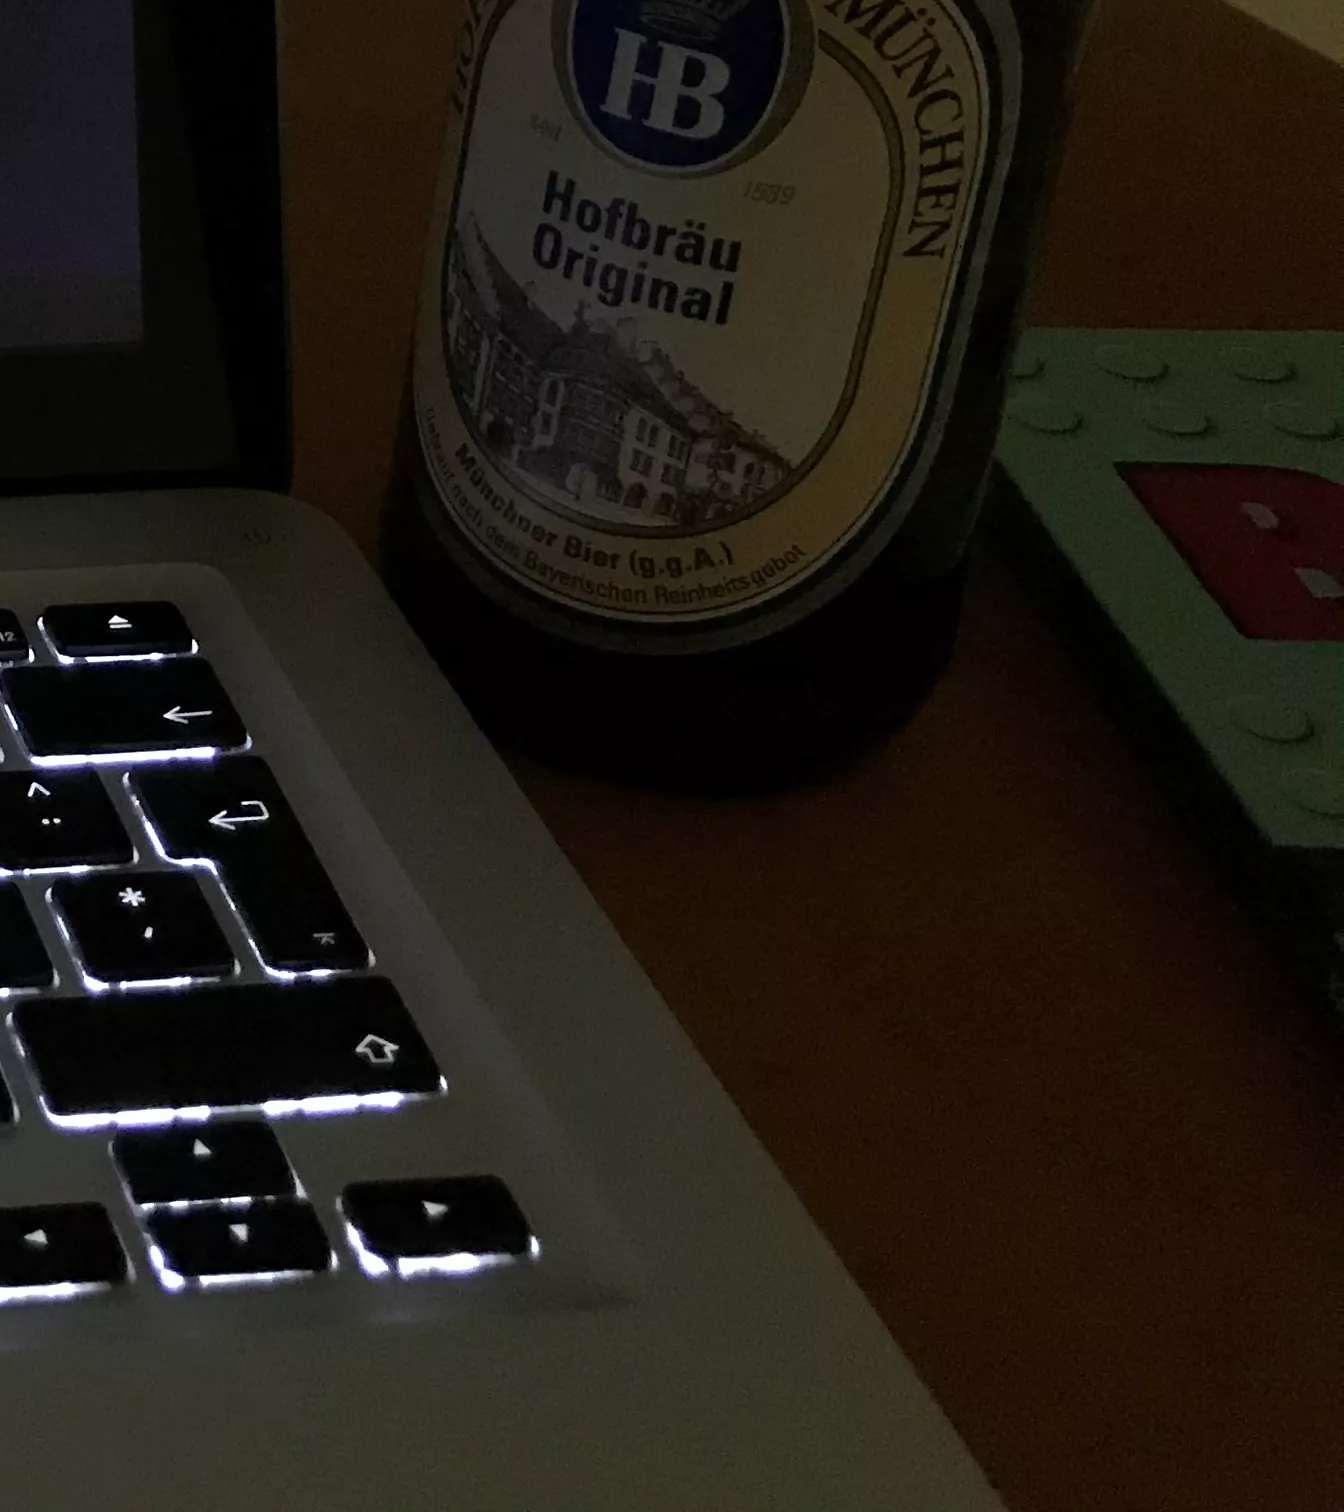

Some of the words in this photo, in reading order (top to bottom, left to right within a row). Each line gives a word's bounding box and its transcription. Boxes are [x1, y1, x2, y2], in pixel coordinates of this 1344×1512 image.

[599, 25, 732, 140] HB
[532, 222, 735, 325] Original
[542, 169, 743, 273] Hofbräu
[454, 442, 559, 547] Münchner
[563, 535, 621, 570] Bier
[628, 540, 735, 580] (g.g.A.)
